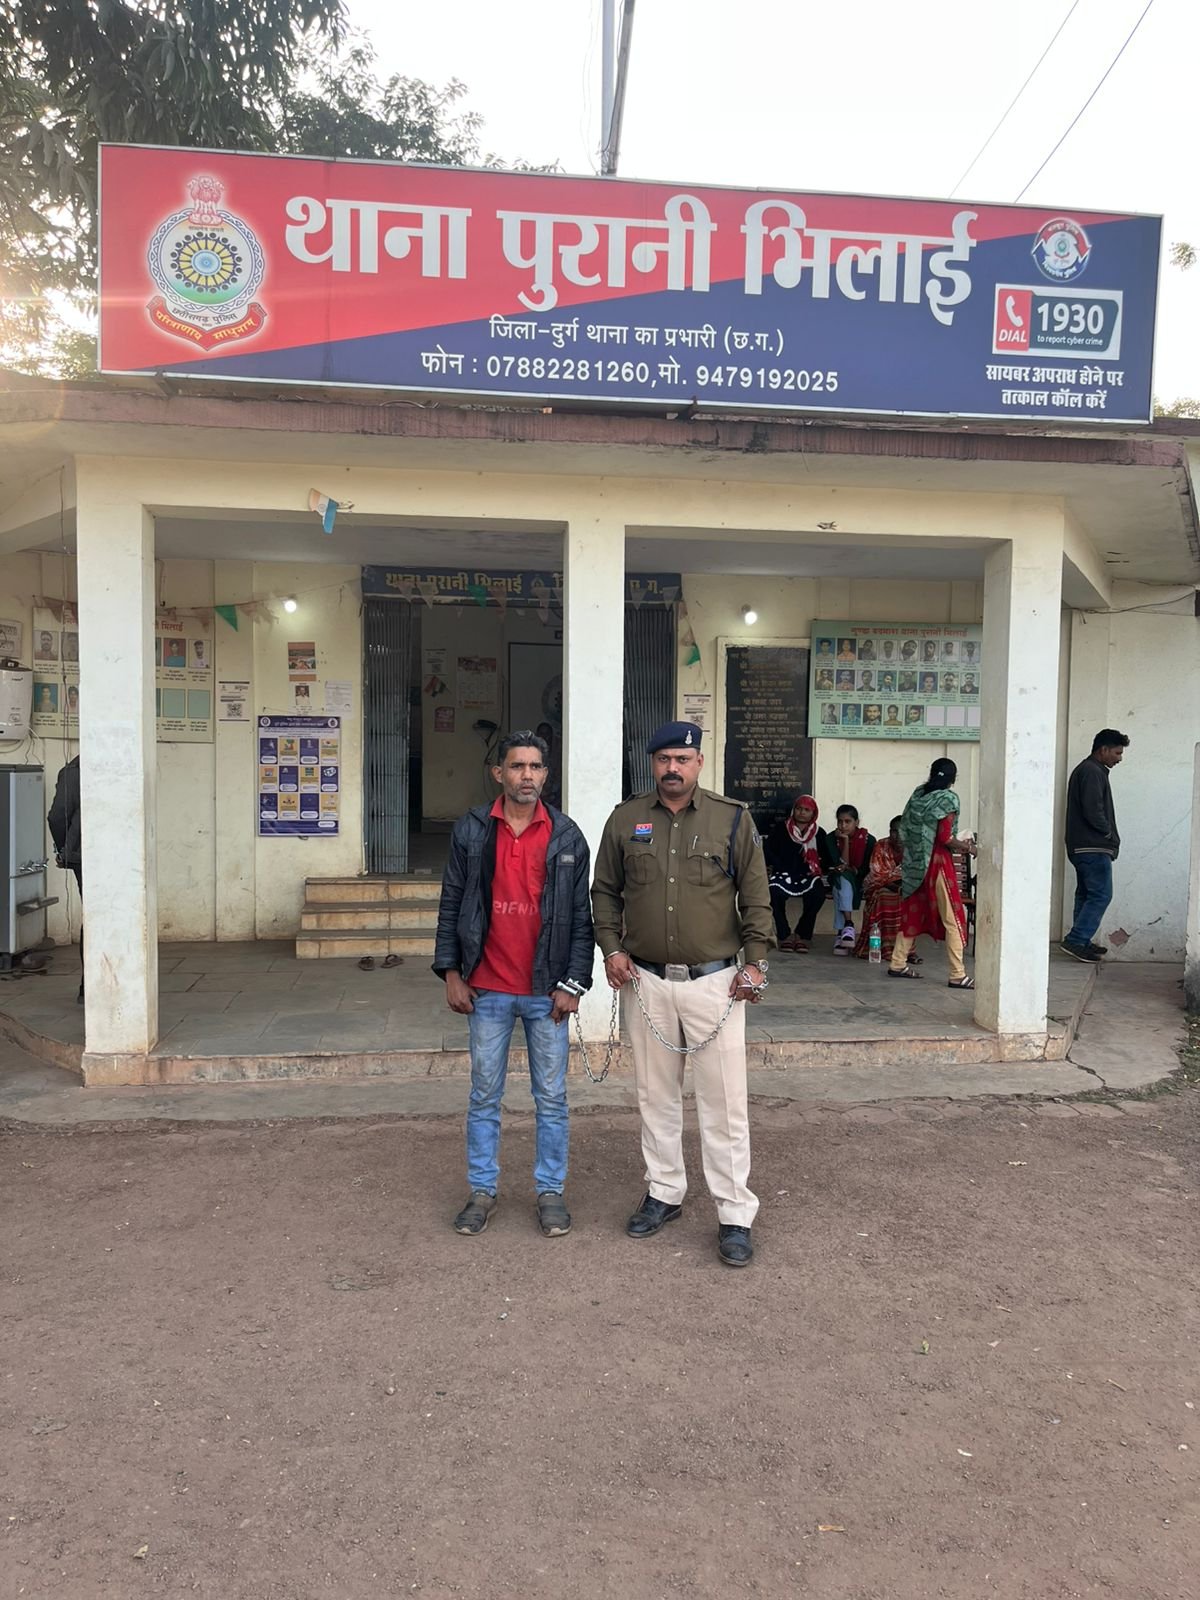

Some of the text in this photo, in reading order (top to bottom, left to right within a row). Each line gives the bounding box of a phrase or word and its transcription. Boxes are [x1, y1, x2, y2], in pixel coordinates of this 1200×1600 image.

[285, 193, 979, 326] थाना पुरानी भिलाई
[1037, 302, 1104, 335] 1930
[489, 314, 784, 356] जिला-दुर्ग थाना का प्रभारी (छ.ग.)
[998, 328, 1027, 343] DIAL
[1037, 335, 1103, 346] to report cyber crime
[420, 345, 465, 375] फोन
[696, 367, 840, 392] 9479192025
[985, 364, 1125, 387] सायबर अपराध होने पर
[1001, 387, 1108, 410] तत्काल कॉल करें
